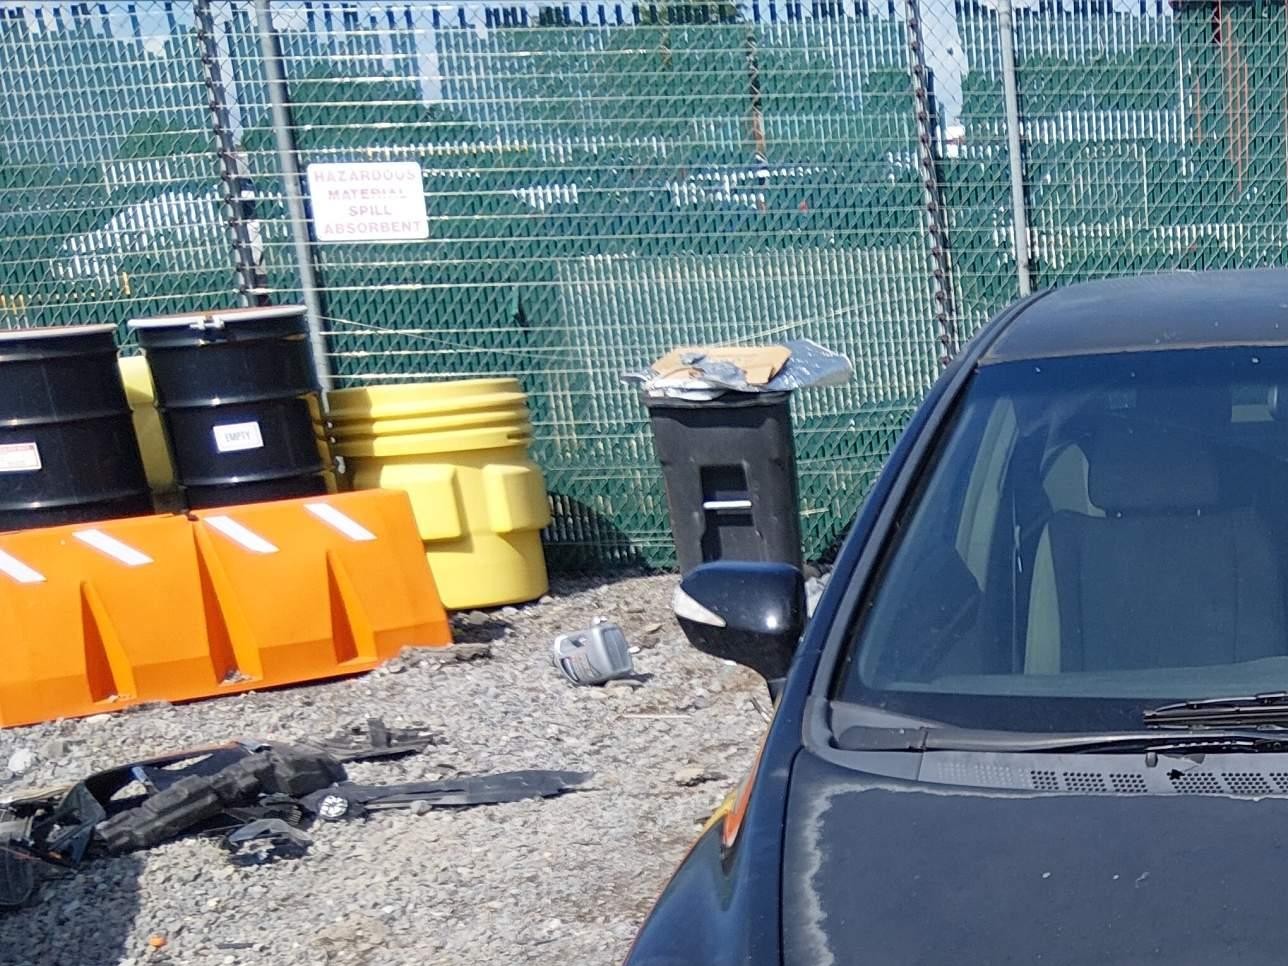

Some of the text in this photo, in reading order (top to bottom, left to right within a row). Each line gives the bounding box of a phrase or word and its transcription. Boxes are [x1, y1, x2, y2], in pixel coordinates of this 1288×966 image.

[313, 169, 416, 182] HAZARDOUS
[327, 188, 408, 200] MATERIAL
[348, 204, 393, 217] SPILL
[324, 221, 421, 235] ABSORBENT
[224, 431, 250, 443] EMPTY
